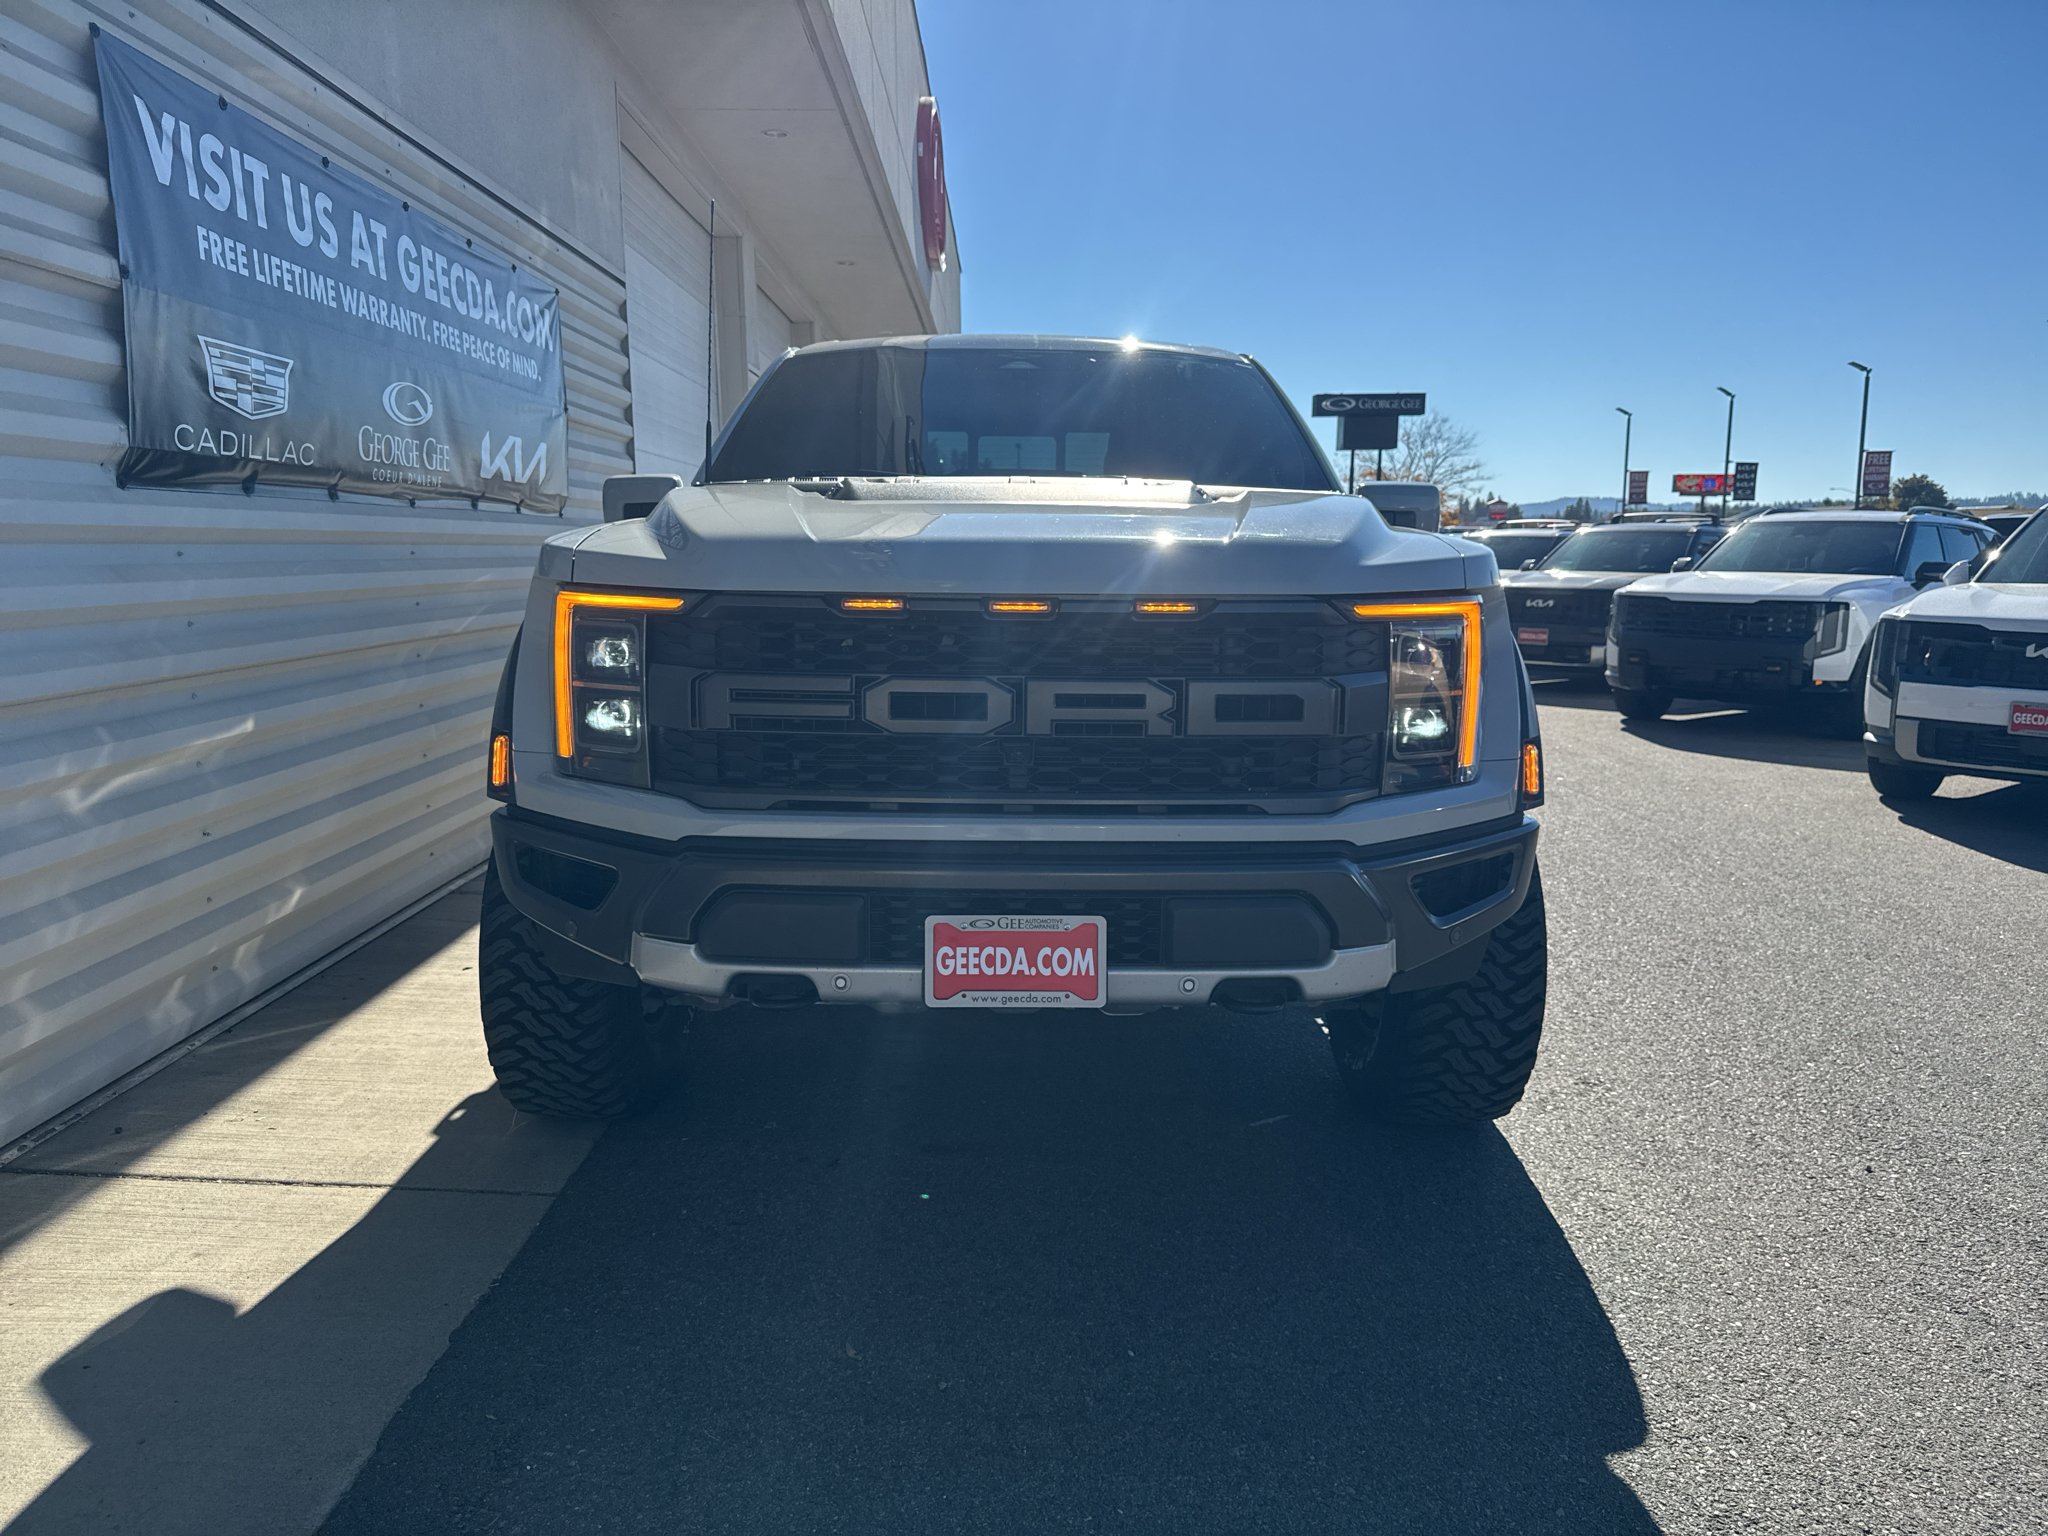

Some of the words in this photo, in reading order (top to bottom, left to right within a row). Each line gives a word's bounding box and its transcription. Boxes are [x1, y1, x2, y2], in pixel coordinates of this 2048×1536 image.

[133, 94, 269, 229] VISIT
[281, 172, 338, 258] US
[351, 210, 387, 281] AT
[397, 234, 554, 352] GEECDA.COM
[196, 225, 250, 277] FREE
[252, 248, 337, 309] LIFETIME
[338, 282, 431, 342] WARRANTY.
[432, 319, 461, 353] FREE
[462, 331, 496, 365] PEACE
[496, 346, 511, 369] OF
[512, 352, 542, 382] MIND.
[174, 423, 315, 466] CADILLAC
[358, 425, 420, 468] GEORGE
[423, 437, 450, 472] GEE
[480, 430, 548, 486] KIA
[1867, 453, 1891, 465] FREE
[372, 467, 404, 483] COEUR
[408, 473, 443, 488] D'ALENE
[1526, 599, 1554, 607] KIA
[694, 674, 1342, 737] FORD
[997, 917, 1024, 930] GEE
[936, 946, 1095, 976] GEECDA.COM
[971, 993, 1062, 1006] www.geecda.com
